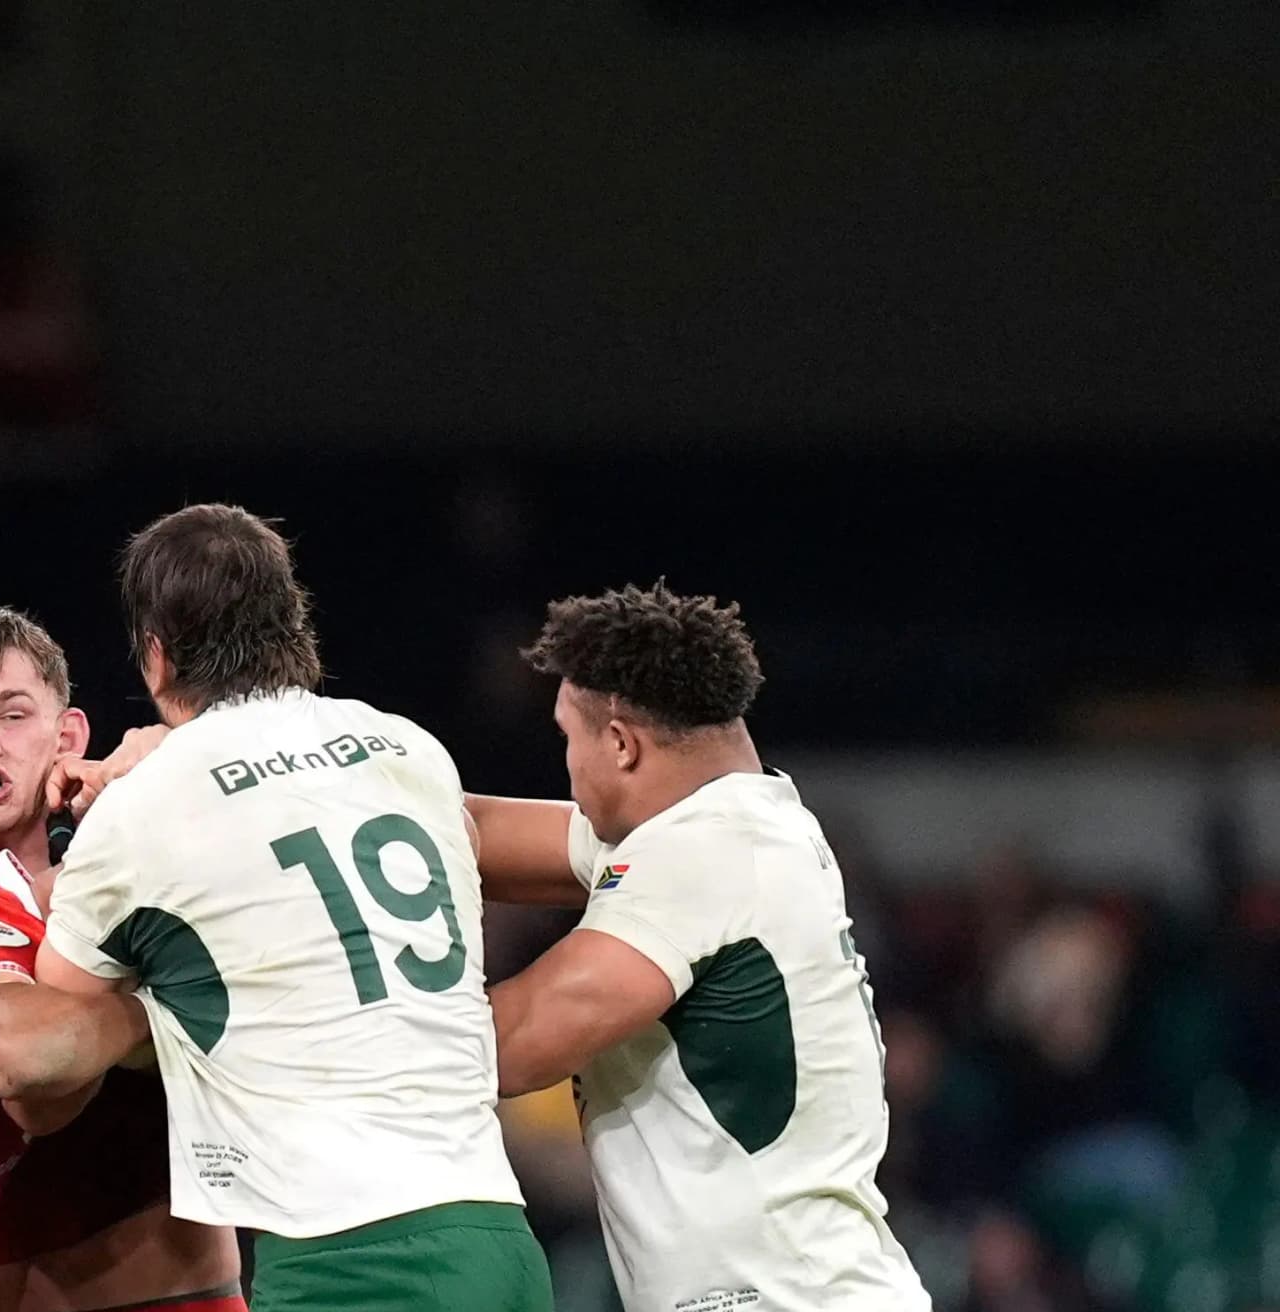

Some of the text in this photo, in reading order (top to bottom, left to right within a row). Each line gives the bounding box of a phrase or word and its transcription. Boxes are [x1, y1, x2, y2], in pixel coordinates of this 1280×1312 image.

[209, 733, 408, 797] Pick n Pay
[268, 813, 468, 1006] 19
